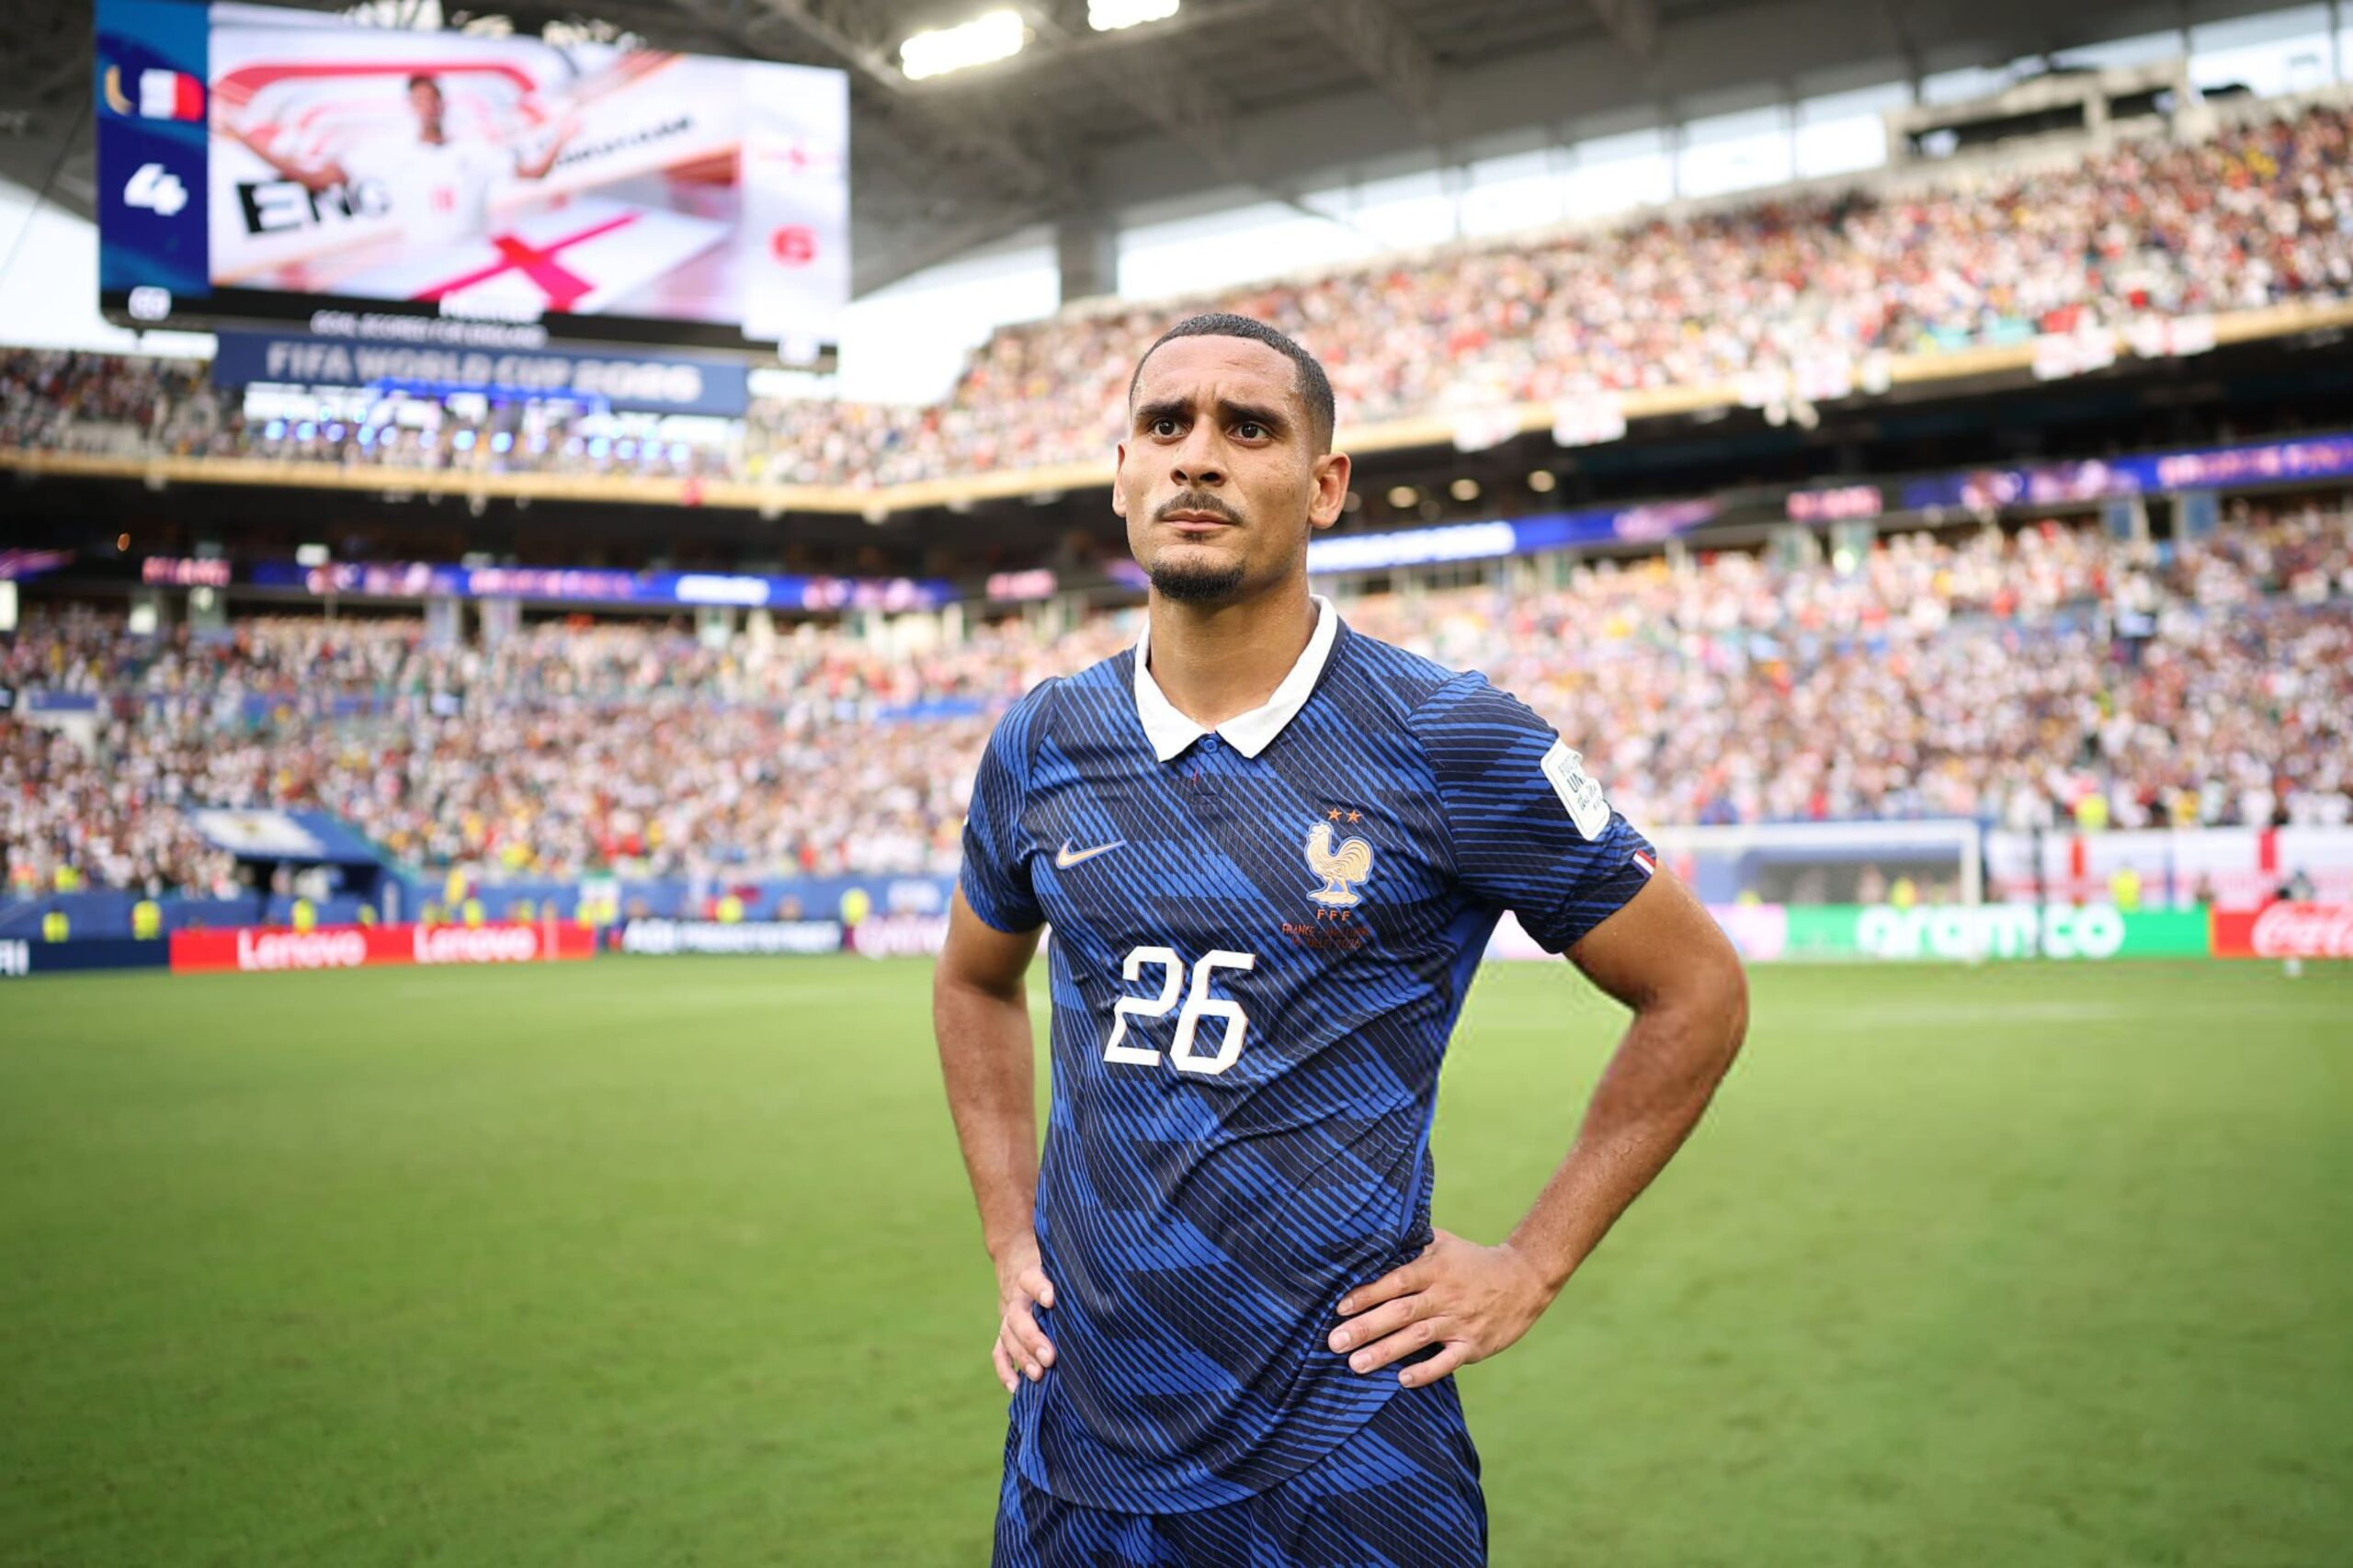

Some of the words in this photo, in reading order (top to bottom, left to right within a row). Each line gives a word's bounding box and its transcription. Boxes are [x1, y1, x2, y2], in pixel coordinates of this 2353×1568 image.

[123, 162, 188, 217] 4
[267, 343, 350, 380] FIFA
[356, 346, 491, 384] WORLD
[496, 354, 570, 391] CUP
[237, 928, 365, 971] Lenovo
[413, 925, 537, 963] Lenovo
[1857, 903, 2125, 959] aramco
[1103, 946, 1256, 1075] 26
